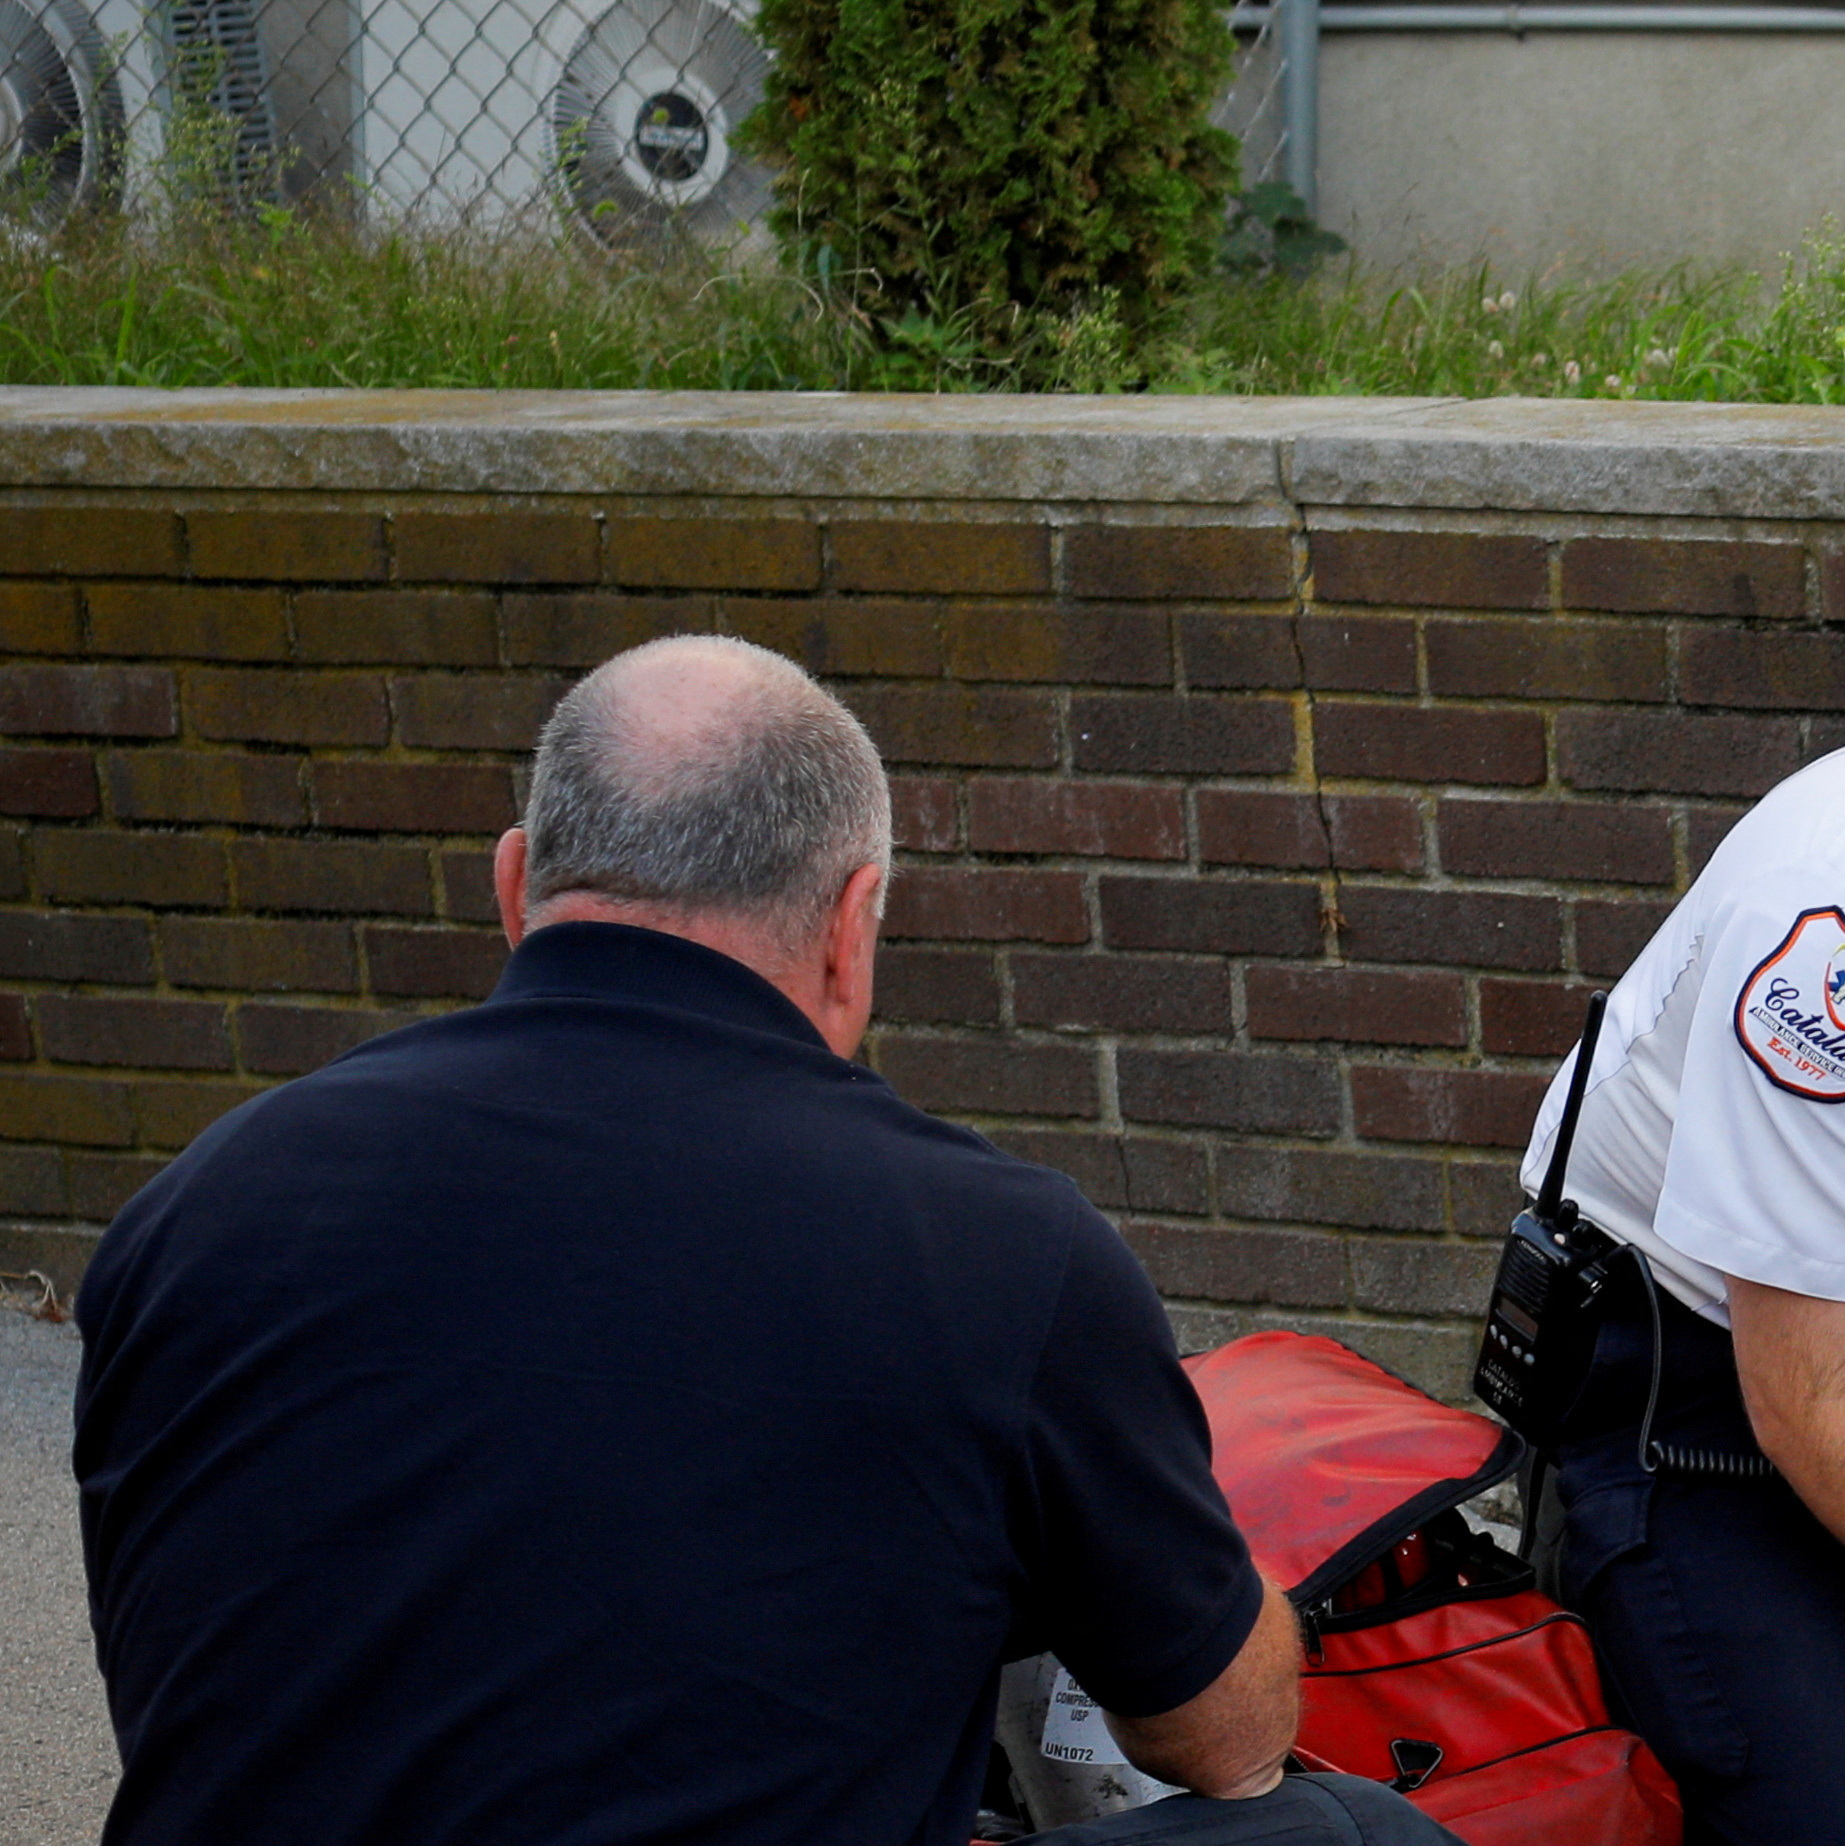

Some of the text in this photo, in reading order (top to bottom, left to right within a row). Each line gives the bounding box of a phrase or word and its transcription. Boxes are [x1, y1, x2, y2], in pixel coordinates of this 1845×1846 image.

[1751, 1006, 1800, 1048] AMBULANCE
[1799, 1042, 1836, 1072] SERVICE
[1766, 1036, 1827, 1081] Est. 1977
[1070, 1709, 1089, 1722] USP
[1045, 1742, 1094, 1761] UN1072
